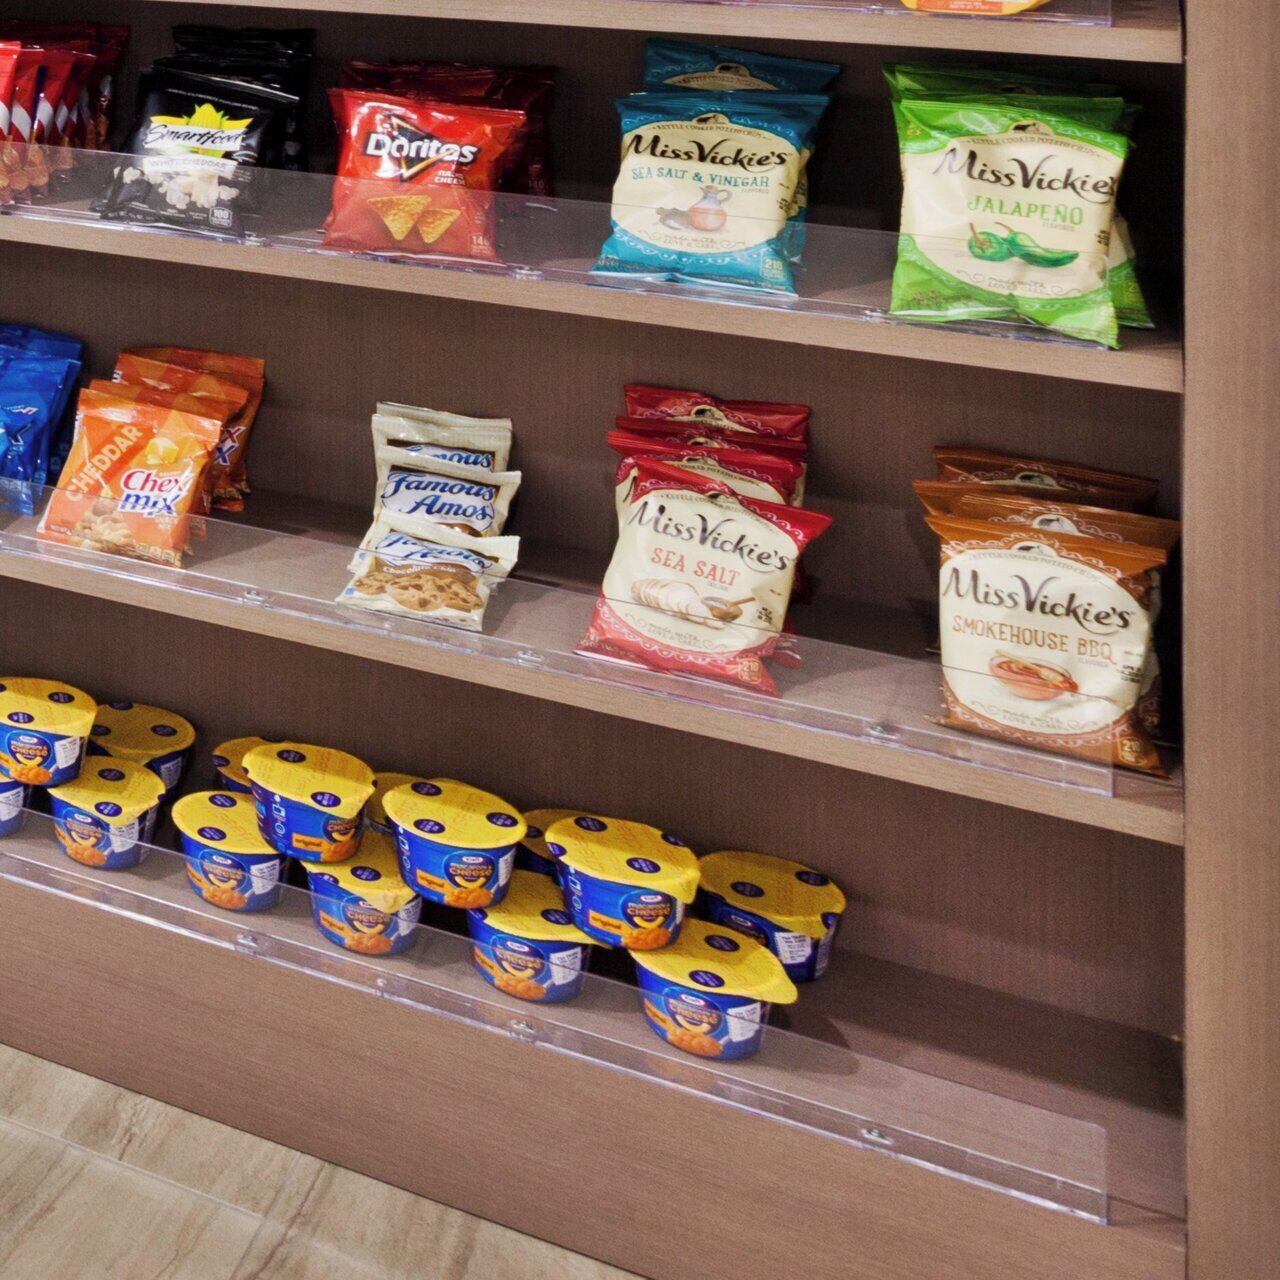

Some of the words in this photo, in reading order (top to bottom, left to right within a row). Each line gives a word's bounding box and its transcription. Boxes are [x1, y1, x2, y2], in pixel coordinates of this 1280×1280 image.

[143, 124, 242, 145] Smartfood
[366, 132, 480, 163] Doritos
[627, 134, 694, 161] Miss
[689, 138, 788, 173] Vickie's
[932, 147, 1015, 188] Miss
[632, 167, 653, 180] SEA
[657, 168, 689, 179] SALT
[692, 172, 704, 183] &
[709, 173, 770, 188] VINEGAR
[65, 424, 144, 503] CHEDDAR
[122, 469, 186, 493] Chex
[381, 470, 496, 501] Famous
[119, 493, 181, 517] mix
[406, 494, 494, 520] Amos
[628, 501, 694, 542] Miss
[697, 513, 790, 573] Vickie's
[651, 547, 686, 572] SEA
[694, 560, 740, 587] SALT
[943, 567, 1020, 609] Miss
[1013, 574, 1131, 636] Vickie's
[952, 614, 1069, 653] SMOKEHOUSE
[1077, 638, 1118, 665] BBQ
